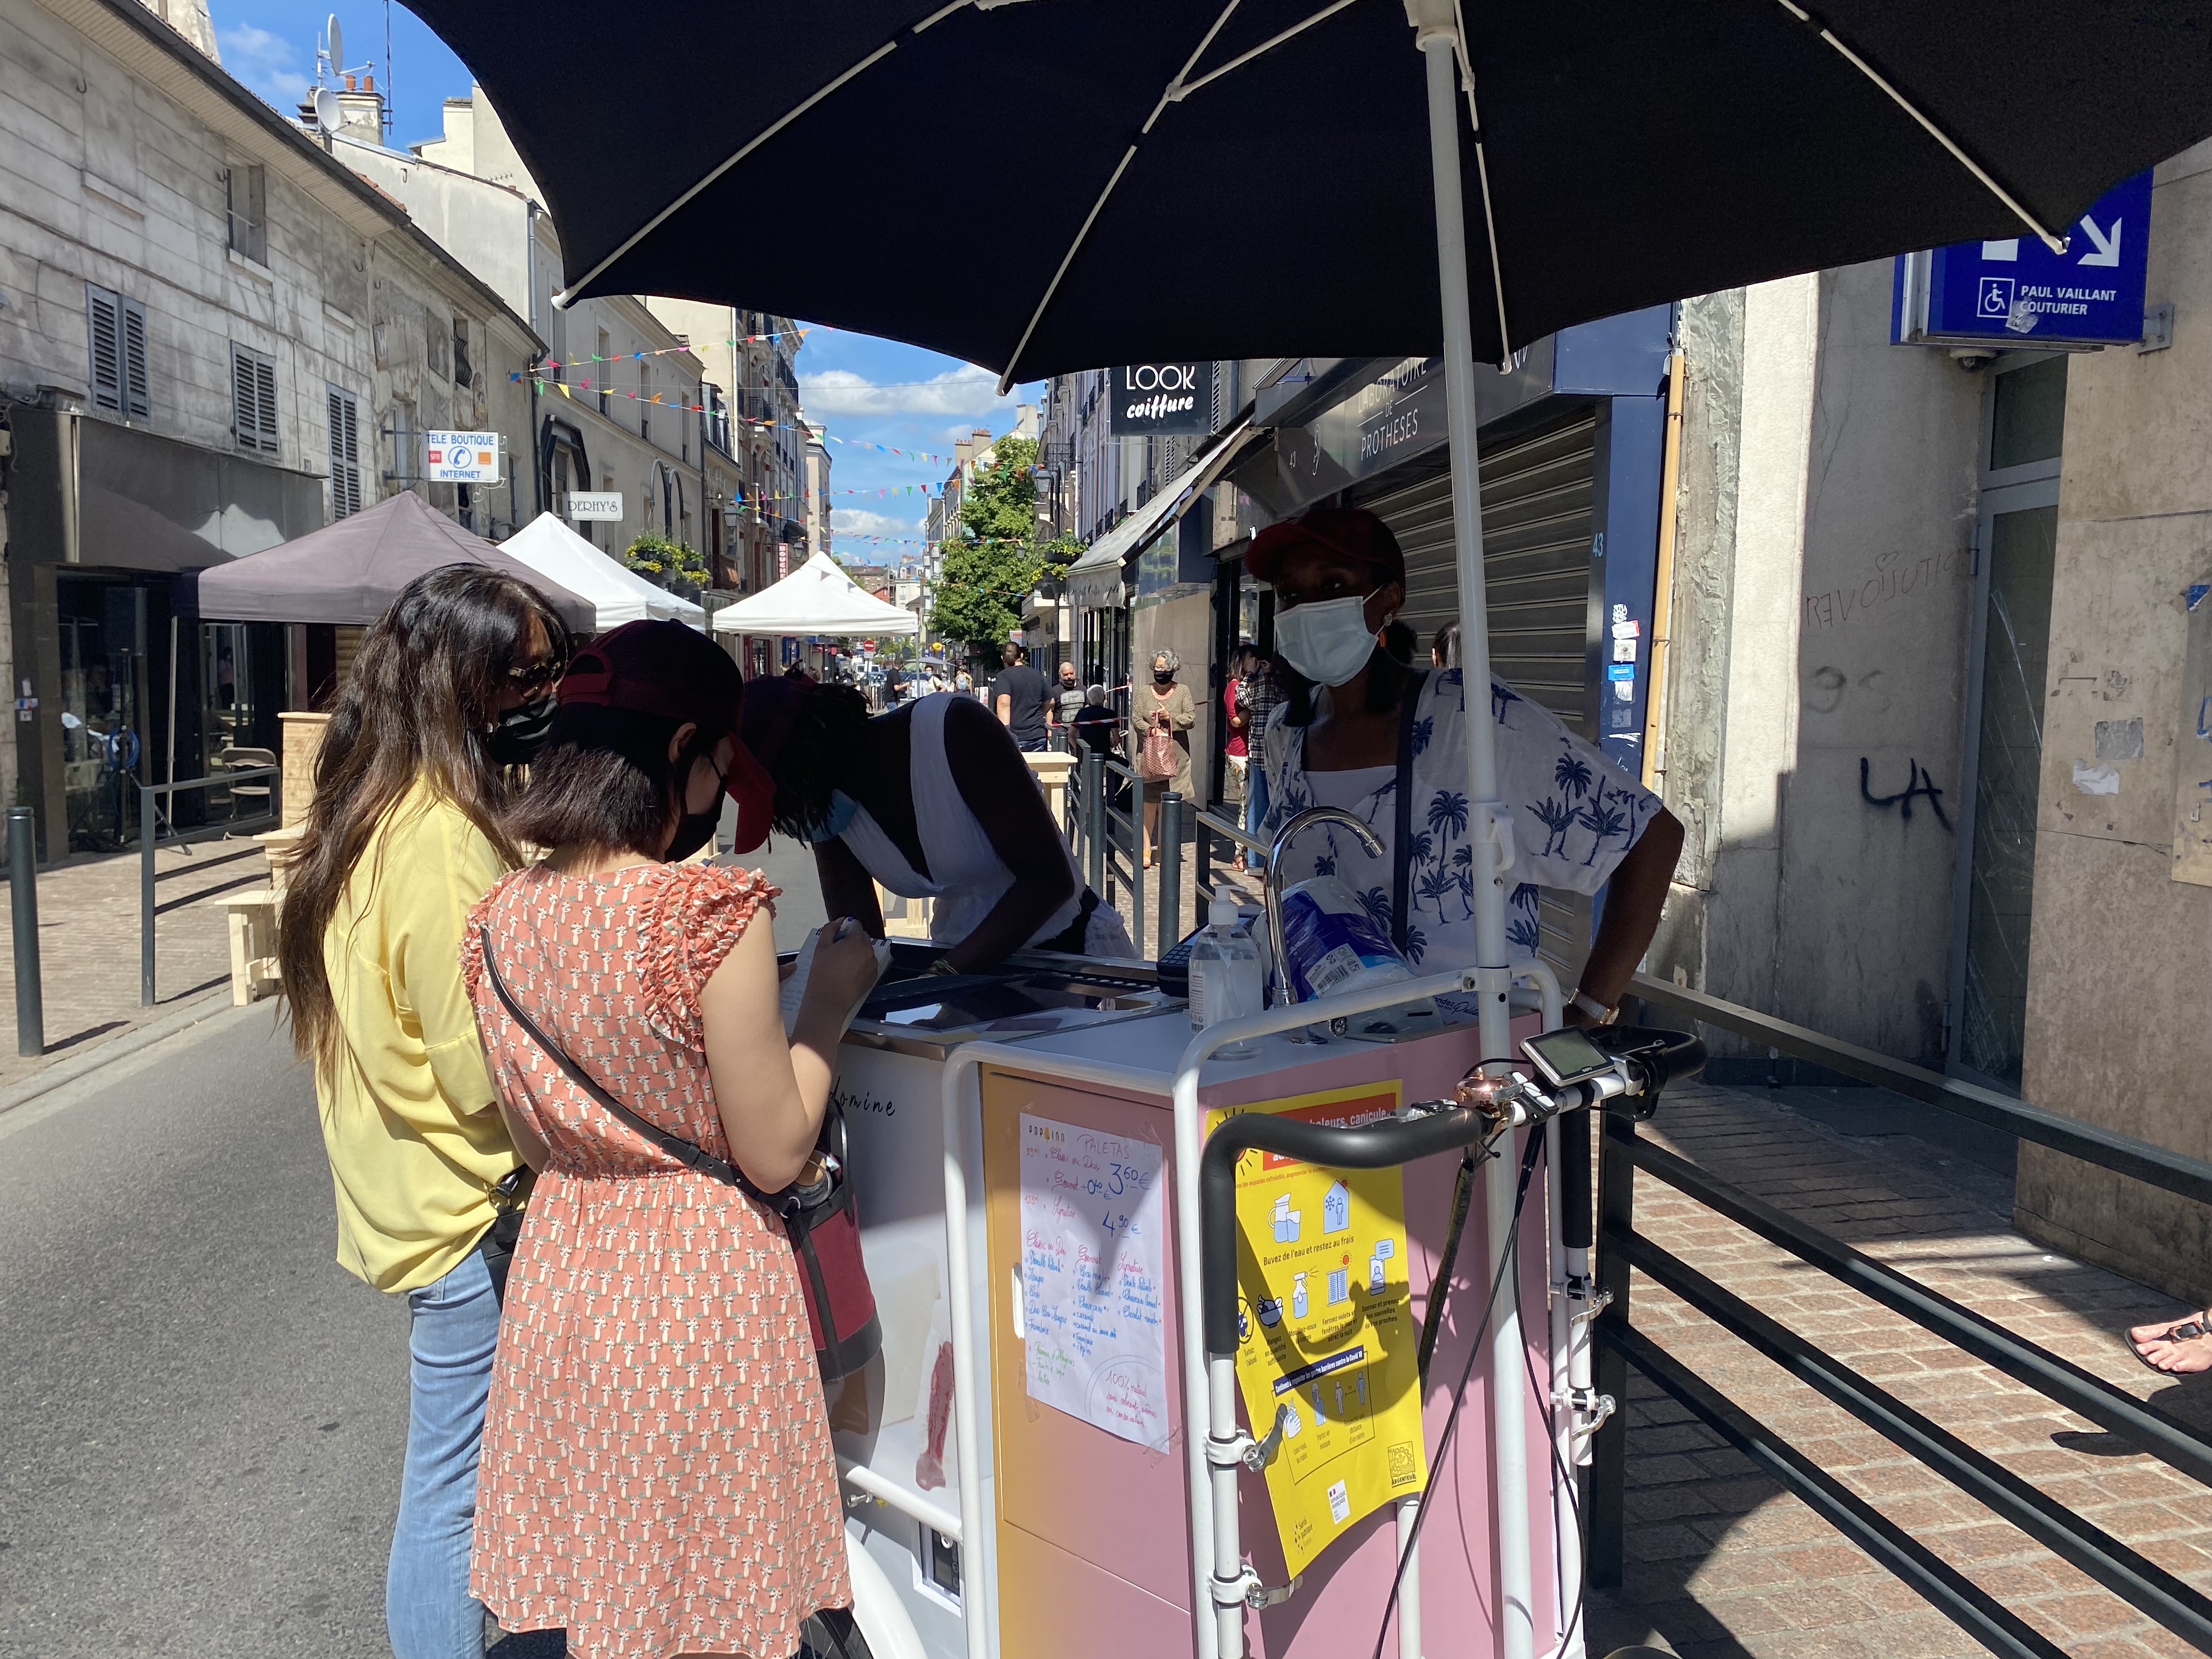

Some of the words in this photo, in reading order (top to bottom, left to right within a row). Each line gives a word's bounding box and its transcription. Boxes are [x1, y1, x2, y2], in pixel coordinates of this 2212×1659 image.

[2021, 285, 2053, 298] PAUL
[2057, 287, 2117, 301] VAILLANT
[2019, 301, 2088, 315] COUTURIER
[1126, 365, 1195, 390] LOOK
[1358, 357, 1427, 414] LABORATOIRE
[1126, 393, 1194, 419] coiffure
[1385, 399, 1393, 417] DE
[426, 434, 447, 443] TELE
[451, 435, 494, 445] BOUTIQUE
[1361, 408, 1418, 461] PROTHESES
[1289, 450, 1296, 469] 43
[440, 470, 481, 478] INTERNET
[567, 500, 618, 512] DERHY'S
[1592, 532, 1604, 557] 43
[1076, 1134, 1129, 1159] PALETAS
[1263, 1255, 1282, 1266] Buvez
[1283, 1251, 1290, 1261] de
[1291, 1249, 1305, 1259] l'eau
[1306, 1245, 1313, 1254] et
[1313, 1241, 1332, 1252] restez
[1341, 1235, 1355, 1245] frais
[1362, 1304, 1377, 1313] Donnez
[1383, 1298, 1400, 1308] prenez
[1374, 1307, 1396, 1318] nouvelles
[1322, 1317, 1338, 1326] Fermez
[1338, 1311, 1351, 1321] volets
[1379, 1315, 1398, 1326] proches
[1300, 1334, 1312, 1344] corps
[1344, 1328, 1352, 1337] nuit
[1267, 1336, 1282, 1346] Mangez
